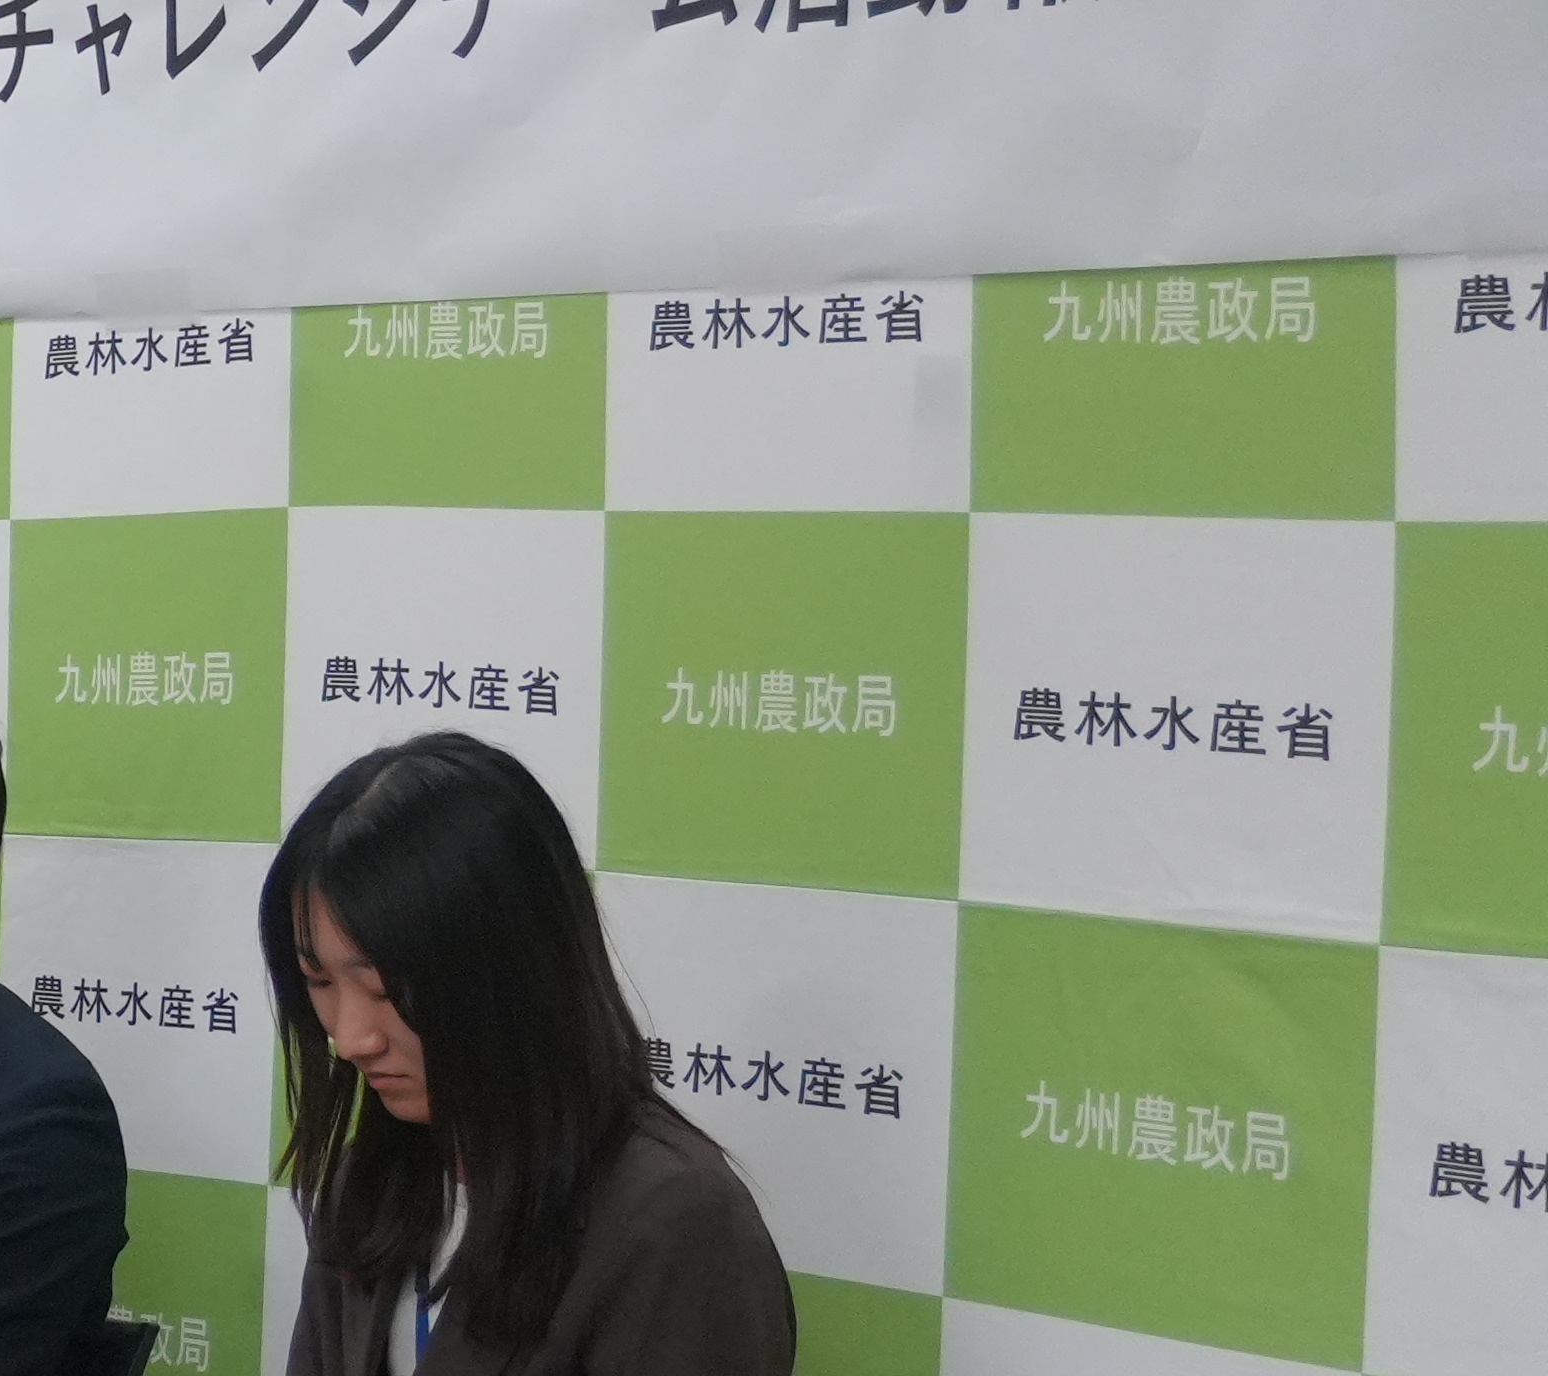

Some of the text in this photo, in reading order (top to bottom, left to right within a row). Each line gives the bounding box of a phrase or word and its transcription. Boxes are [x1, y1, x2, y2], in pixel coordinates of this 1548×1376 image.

[343, 299, 550, 361] 九州農政局
[648, 290, 926, 354] 農林水産省
[1041, 276, 1318, 347] 九州農政局
[44, 317, 257, 381] 農林水産省
[55, 650, 234, 707] 九州農政局
[321, 654, 562, 717] 農林水産省
[660, 666, 897, 739] 九州農政局
[1012, 686, 1334, 763] 農林水産省
[30, 973, 240, 1035] 農林水産省
[1019, 1080, 1293, 1180] 九州農政局
